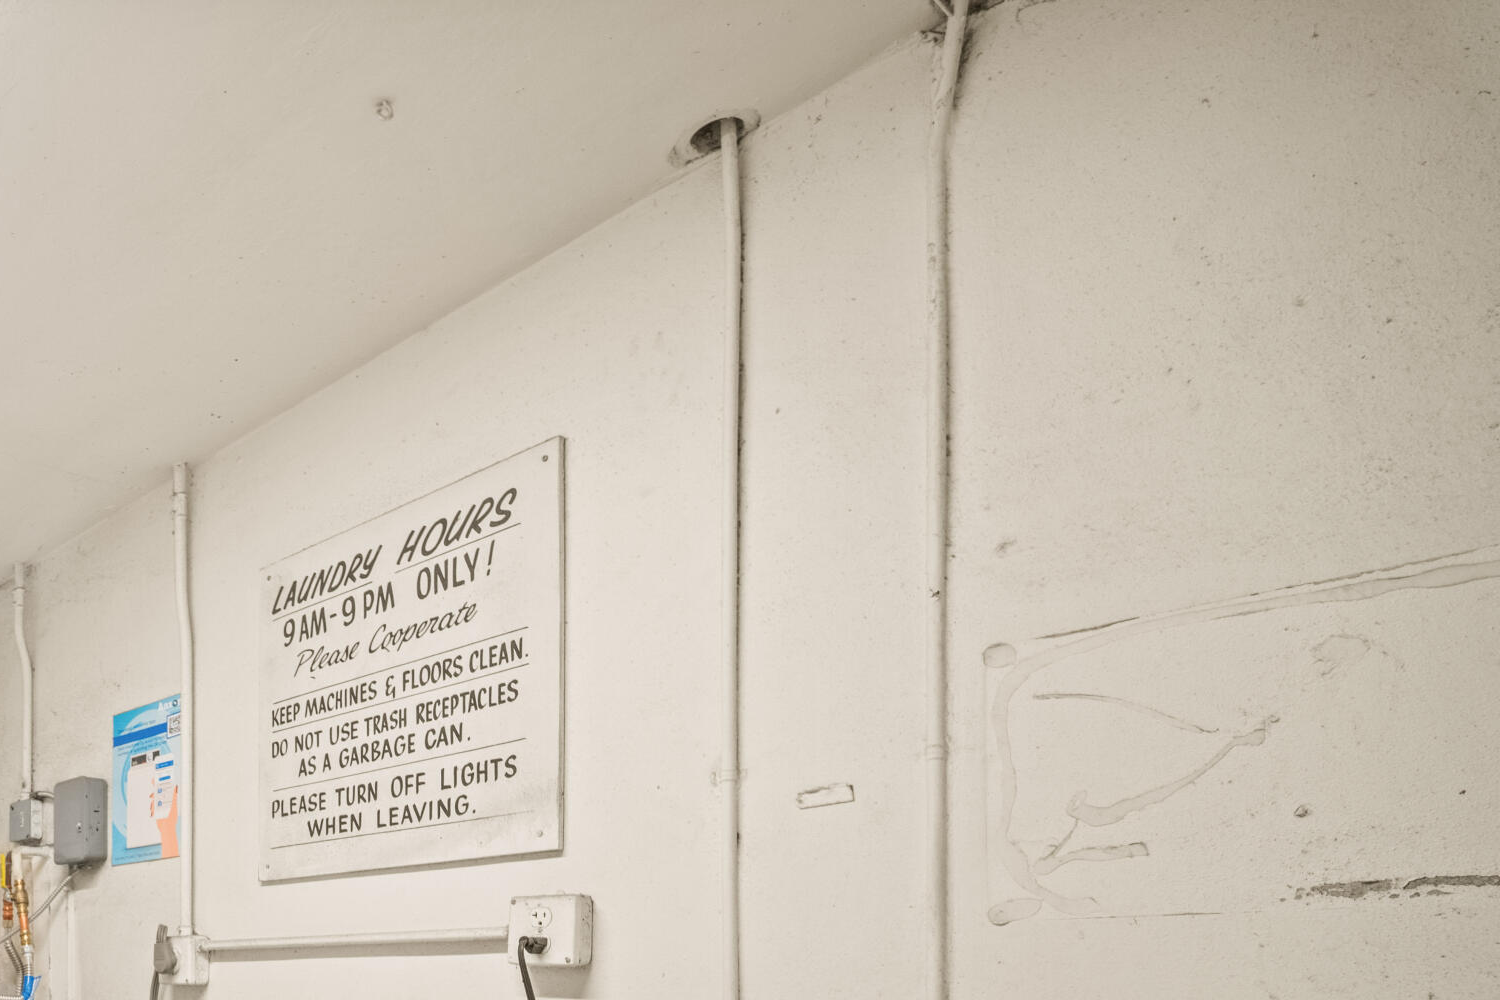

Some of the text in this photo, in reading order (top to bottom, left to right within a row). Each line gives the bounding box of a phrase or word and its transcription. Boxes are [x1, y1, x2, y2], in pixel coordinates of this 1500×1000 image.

[272, 487, 517, 615] LAUNDRY HOURS
[416, 540, 495, 600] ONLY!
[294, 601, 478, 678] Please Cooperate
[271, 637, 530, 727] KEEP MACHINES & FLOORS CLEAN.
[271, 679, 519, 759] DO NOT USE TRASH RECEPTACLES
[298, 722, 471, 778] AS A GARBAGE CAN.
[271, 754, 518, 819] PLEASE TURN OFF LIGHTS
[307, 794, 476, 837] WHEN LEAVING.
